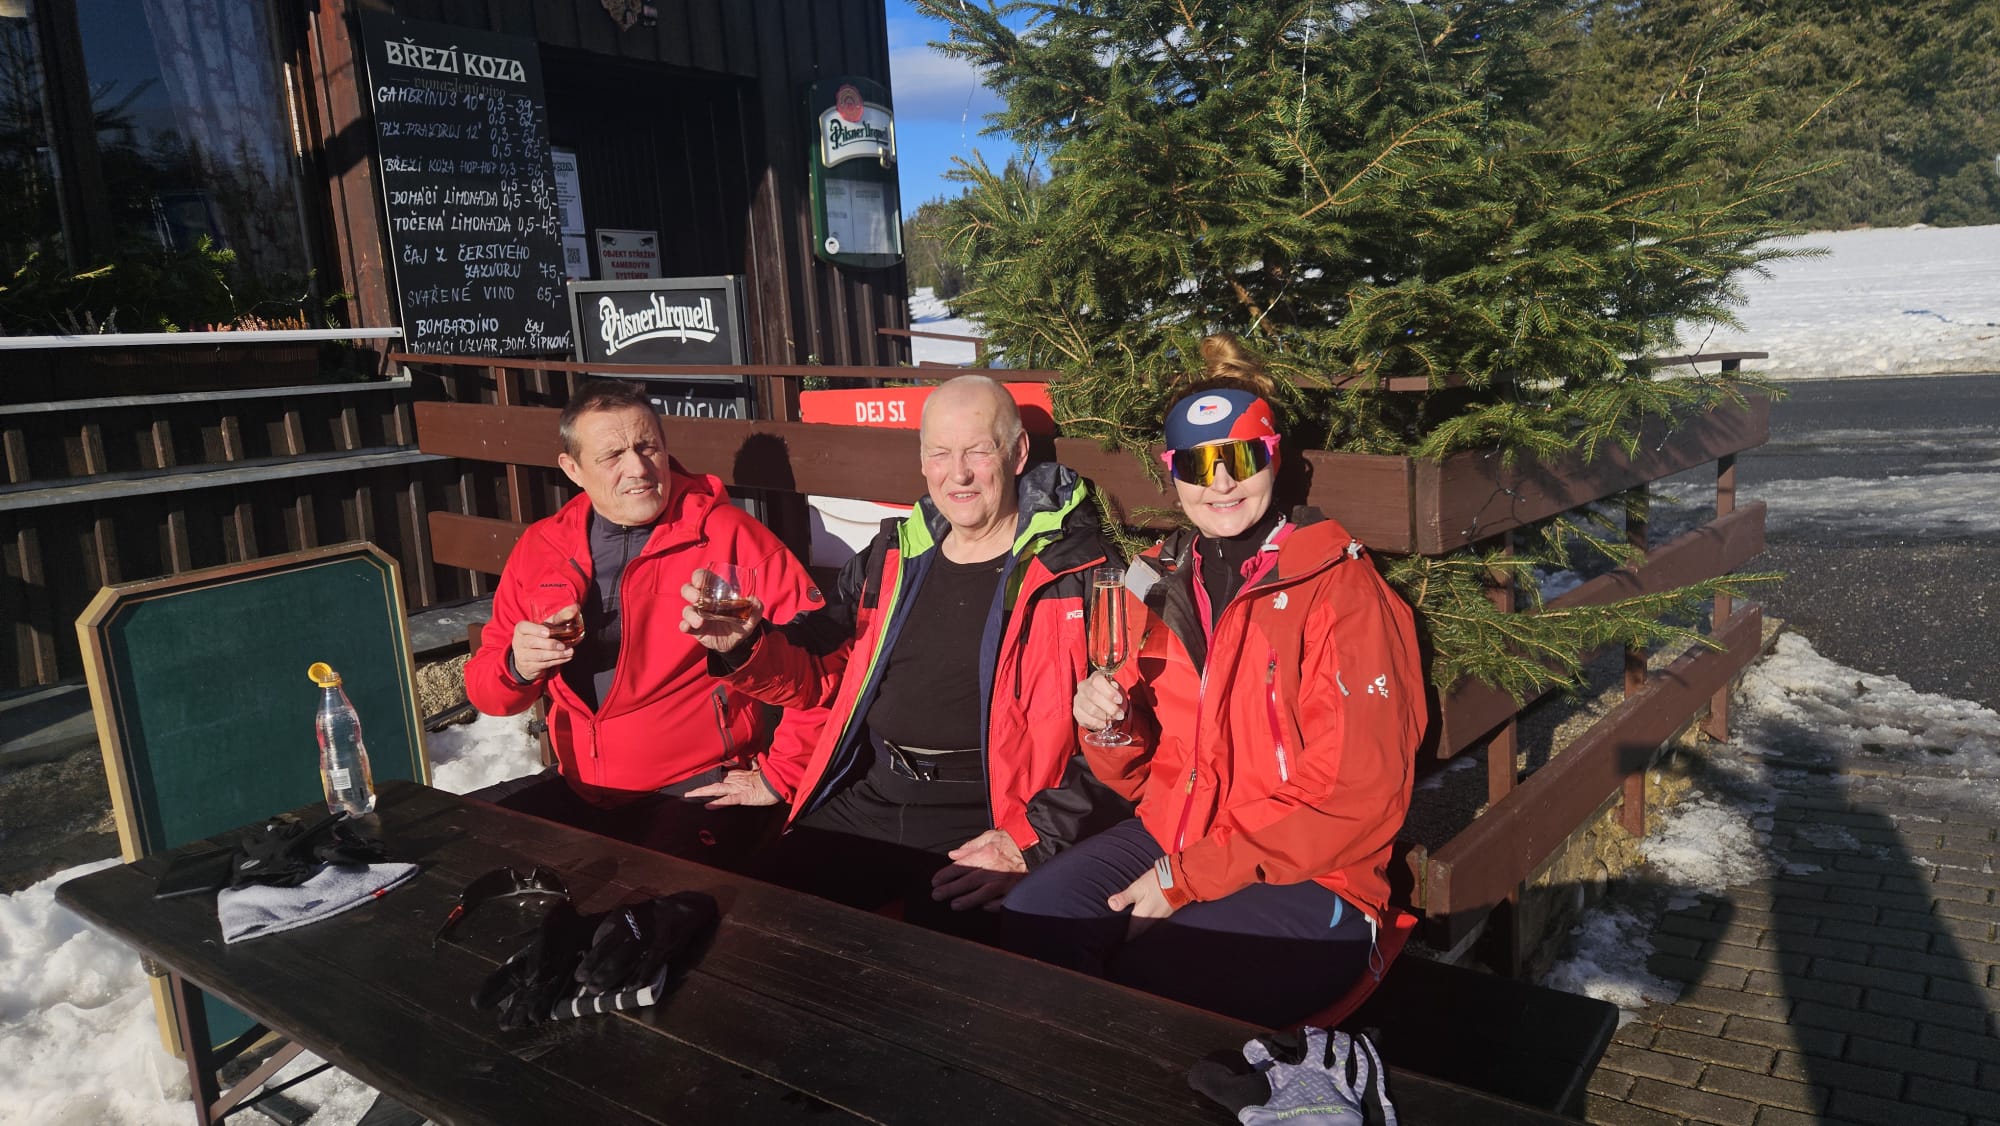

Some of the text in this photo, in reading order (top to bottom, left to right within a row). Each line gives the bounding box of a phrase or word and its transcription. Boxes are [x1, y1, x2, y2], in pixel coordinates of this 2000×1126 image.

[384, 37, 527, 83] BŘEZÍ KOZA
[830, 119, 864, 149] Pilsner
[403, 244, 428, 265] ČAJ
[483, 286, 515, 301] VINO
[598, 296, 656, 356] Pilsner
[855, 400, 907, 423] DEJ SI
